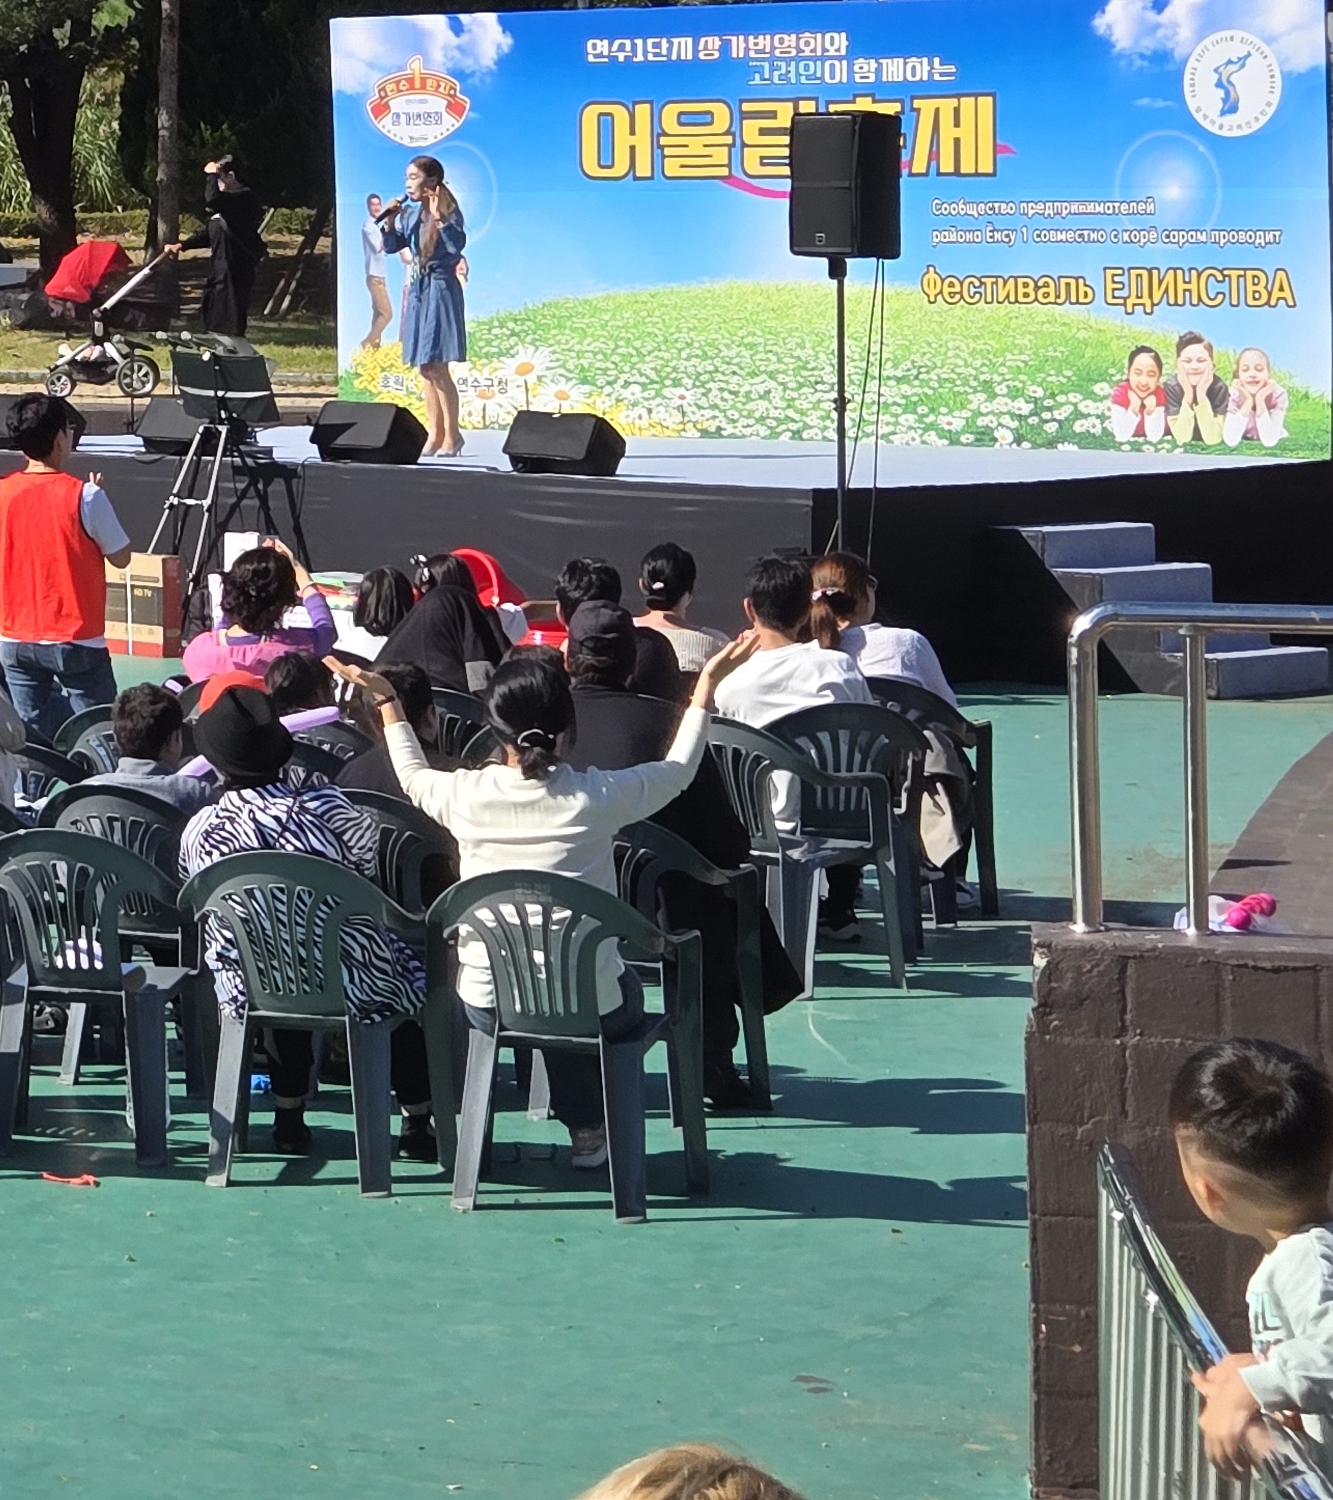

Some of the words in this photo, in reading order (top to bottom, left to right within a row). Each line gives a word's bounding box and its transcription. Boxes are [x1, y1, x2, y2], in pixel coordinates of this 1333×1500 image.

[586, 37, 693, 63] 연수1단지
[698, 32, 849, 61] 상가번영회와
[747, 59, 848, 86] 고려인이
[853, 56, 957, 83] 함께하는
[579, 93, 998, 181] 어울림제
[931, 198, 1016, 218] Сообщество
[1019, 196, 1156, 219] предпринимателей
[931, 224, 982, 246] района
[985, 222, 1016, 247] Ёнсу
[1021, 226, 1028, 243] 1
[1032, 228, 1106, 243] совместно
[1110, 229, 1120, 243] с
[1123, 225, 1159, 246] корё
[1161, 229, 1207, 245] сарам
[1209, 229, 1282, 247] проводит
[1103, 266, 1296, 315] ЕДИНСТВА
[456, 376, 509, 395] 연수구청
